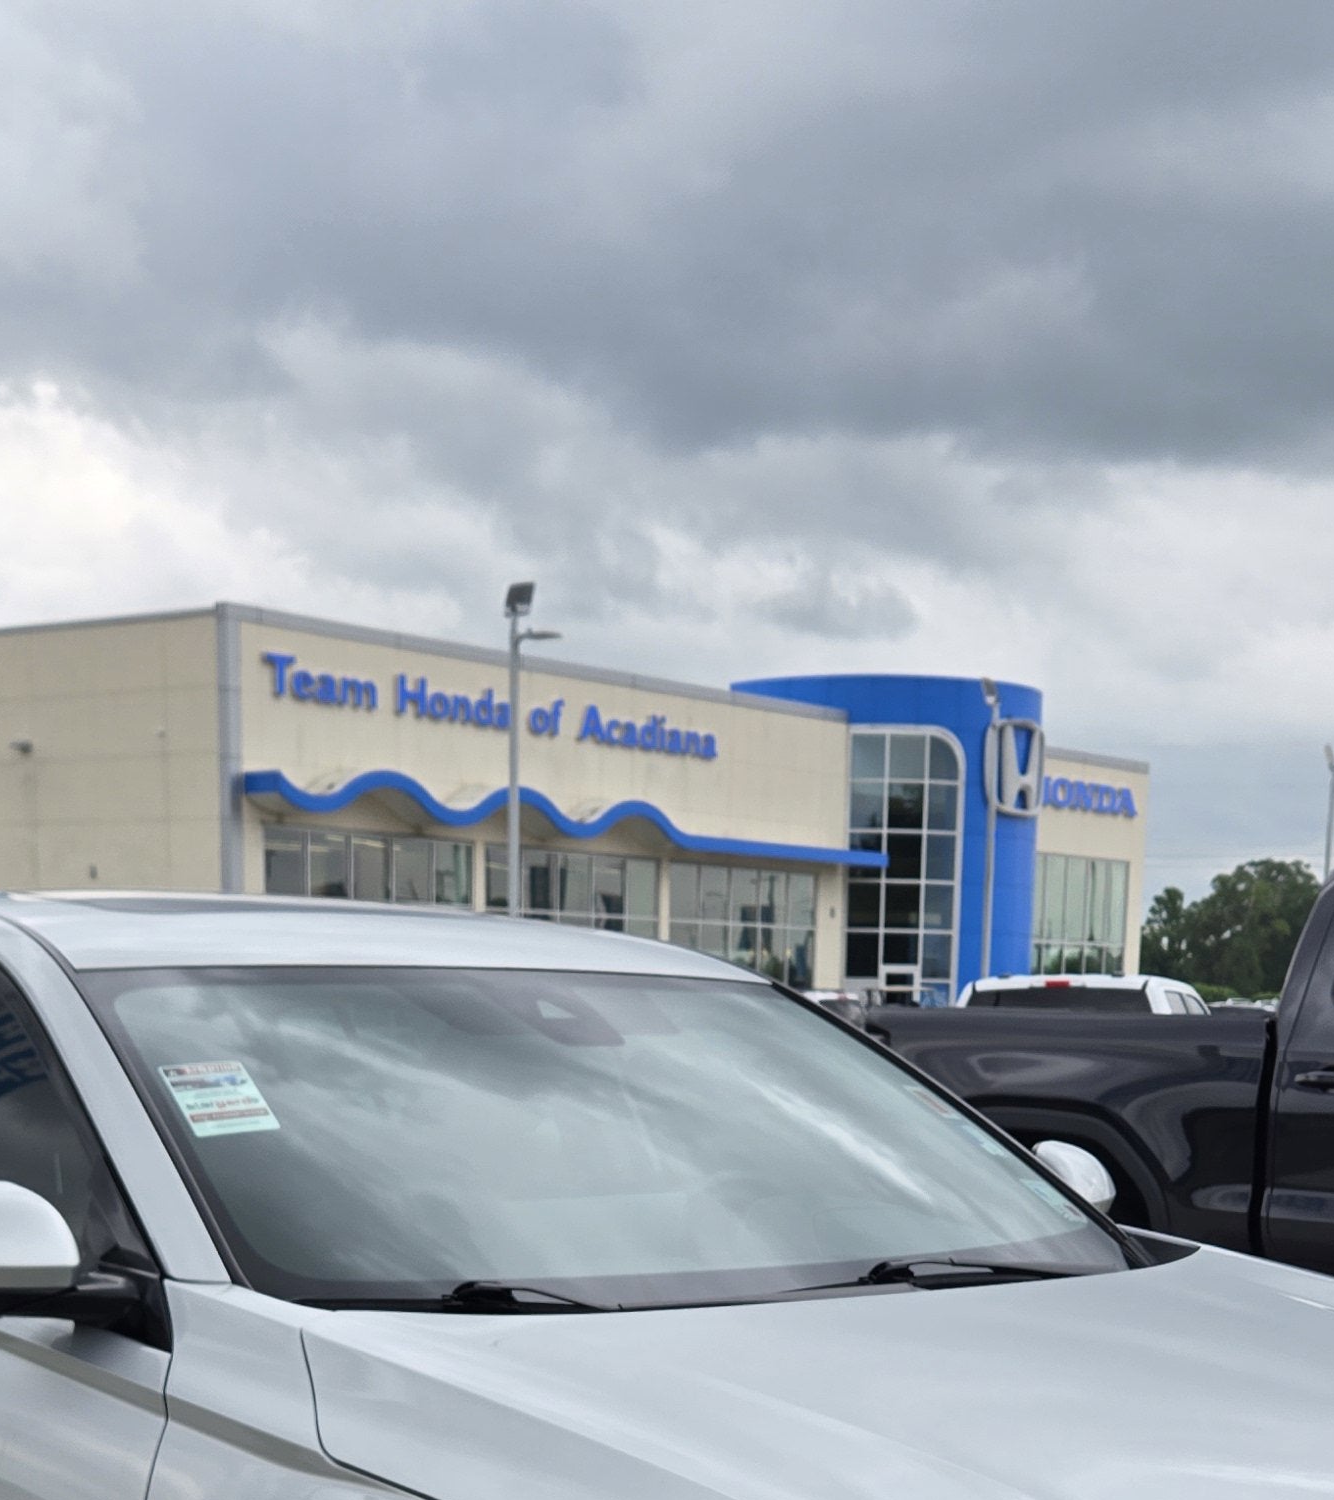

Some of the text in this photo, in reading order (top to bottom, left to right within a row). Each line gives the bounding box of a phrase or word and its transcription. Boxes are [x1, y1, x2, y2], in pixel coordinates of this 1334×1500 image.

[262, 651, 718, 761] Team Honda of Acadiana
